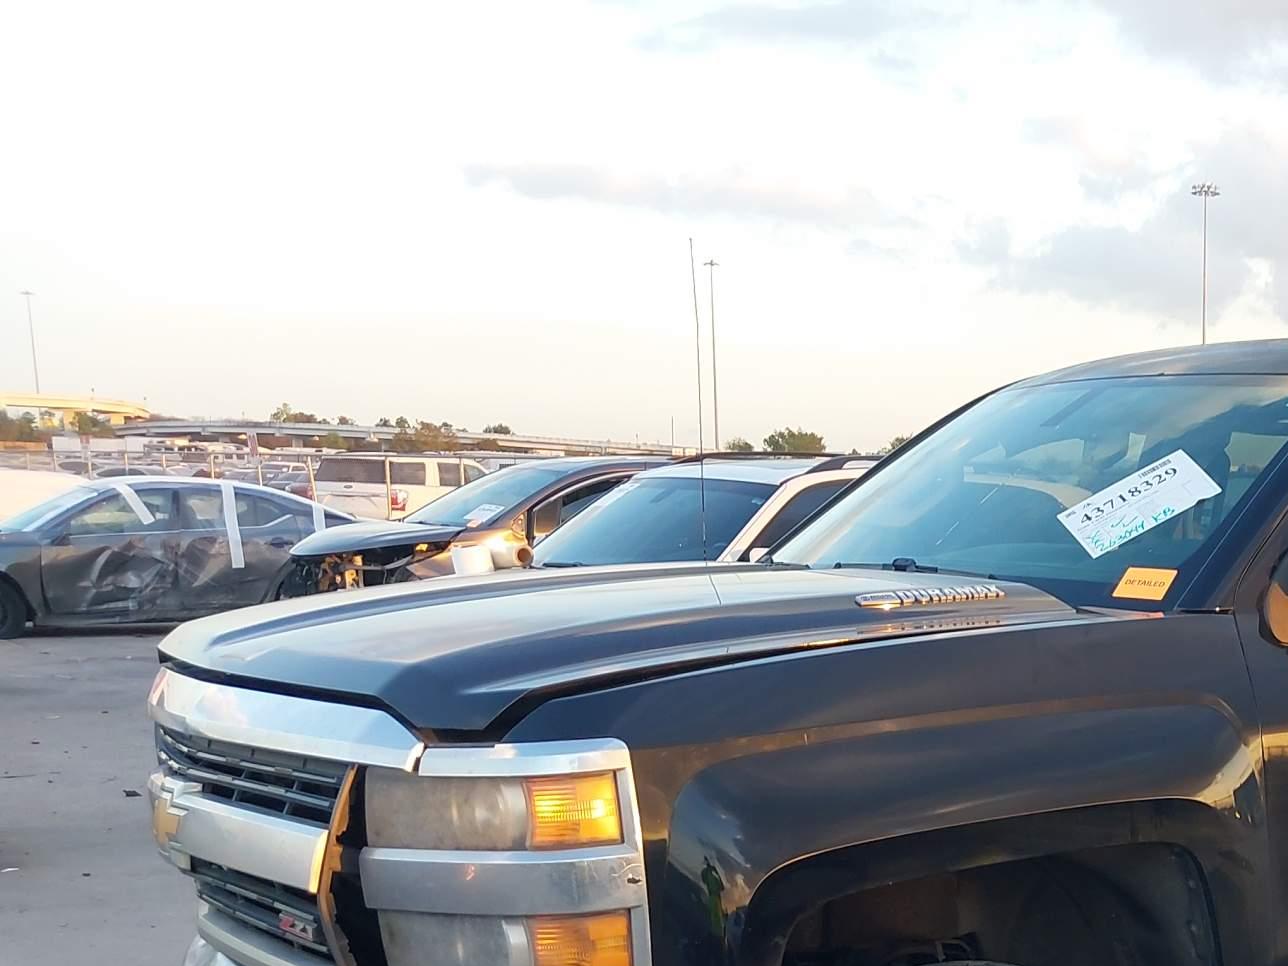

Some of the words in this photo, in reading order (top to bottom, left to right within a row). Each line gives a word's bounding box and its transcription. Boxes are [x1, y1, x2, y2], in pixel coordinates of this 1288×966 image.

[1080, 466, 1178, 525] 43718329
[1124, 578, 1166, 588] DETAILED
[896, 584, 1005, 606] DURAMAX
